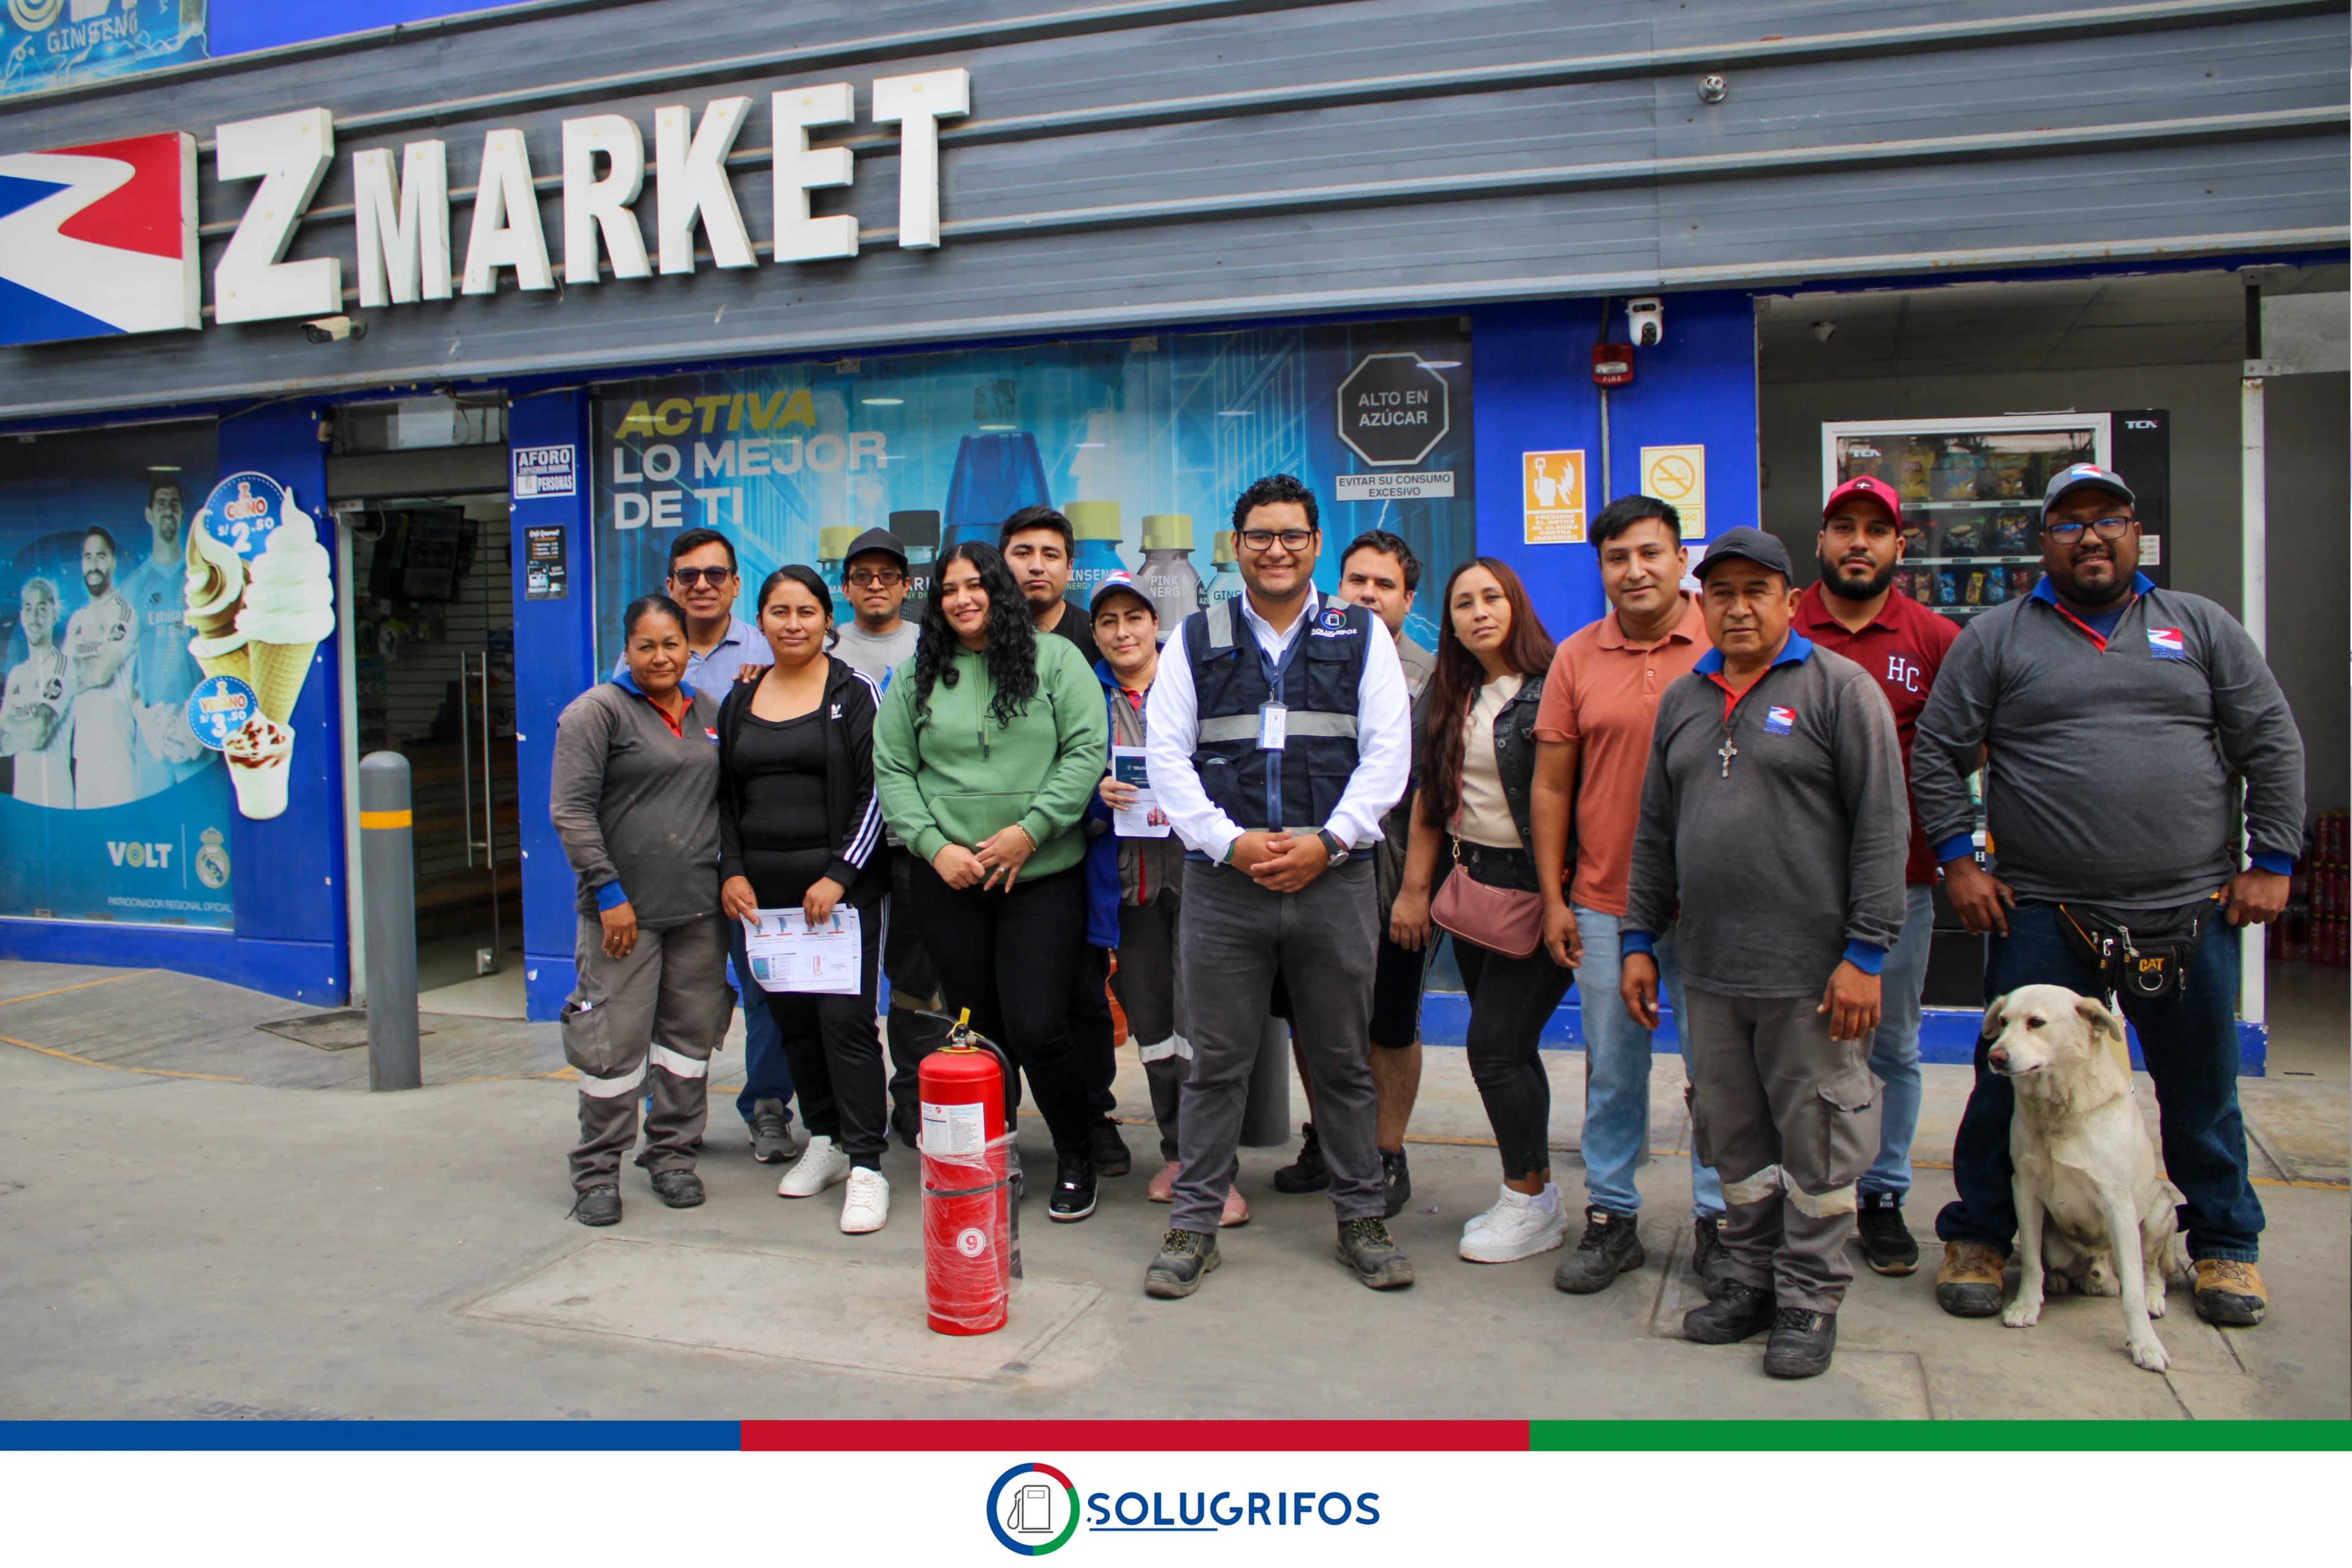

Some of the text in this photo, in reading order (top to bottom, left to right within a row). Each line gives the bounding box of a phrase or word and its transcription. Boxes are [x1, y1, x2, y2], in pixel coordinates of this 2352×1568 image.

[47, 11, 138, 53] GINSENG
[215, 68, 970, 325] Z MARKET
[1359, 390, 1428, 407] ALTO EN
[614, 389, 816, 439] ACTIVA
[1359, 408, 1428, 427] AZÚCAR
[519, 449, 570, 467] AFORO
[614, 431, 888, 483] LO MEJOR
[538, 475, 573, 492] PERSONAS
[1339, 473, 1450, 486] EVITAR SU CONSUMO
[1369, 487, 1420, 497] EXCESIVO
[225, 497, 268, 520] CONO
[614, 487, 744, 530] DE TI
[1071, 569, 1114, 581] INSEN
[1151, 575, 1178, 586] PINK
[1150, 586, 1186, 598] NERGY
[1214, 590, 1241, 600] GINS
[2150, 648, 2185, 659] ZEUS
[107, 841, 173, 869] VOLT
[2139, 957, 2165, 972] CAT
[966, 1235, 978, 1251] 9
